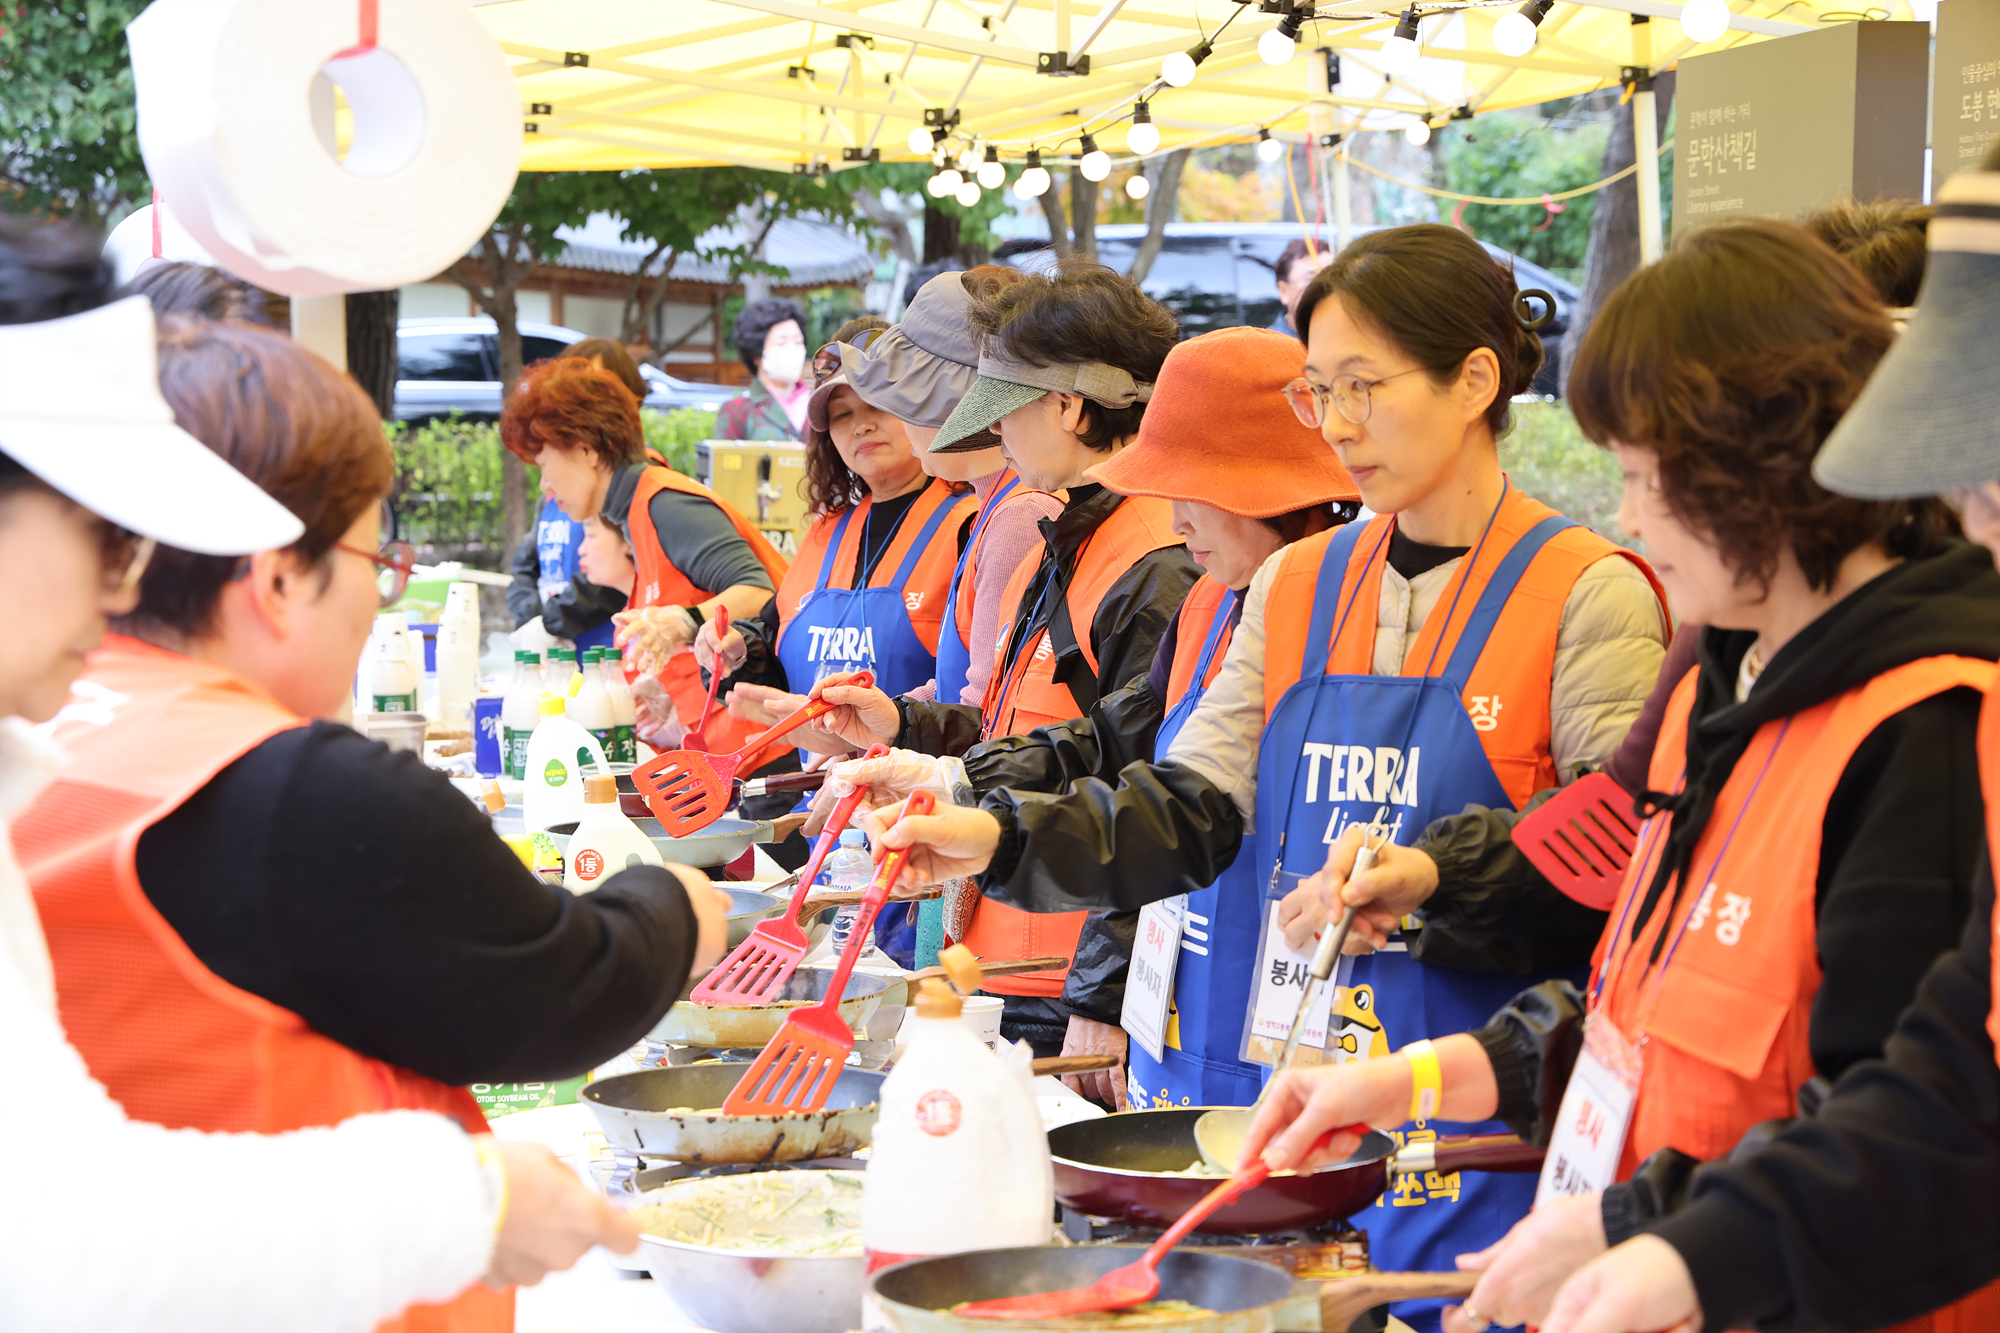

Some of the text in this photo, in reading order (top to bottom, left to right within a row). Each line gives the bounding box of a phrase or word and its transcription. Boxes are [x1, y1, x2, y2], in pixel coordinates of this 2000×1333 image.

[1960, 91, 1984, 122] 도봉
[1687, 128, 1756, 178] 문학산책길
[905, 591, 925, 611] 장
[807, 625, 876, 663] TERRA
[1468, 694, 1503, 732] 장
[1302, 742, 1420, 808] TERRA
[579, 857, 598, 873] 1등
[1146, 918, 1165, 954] 행사
[1136, 955, 1162, 1000] 봉사자
[1270, 958, 1325, 996] 봉사
[496, 1093, 528, 1103] SOYBEAN
[528, 1092, 541, 1101] OIL
